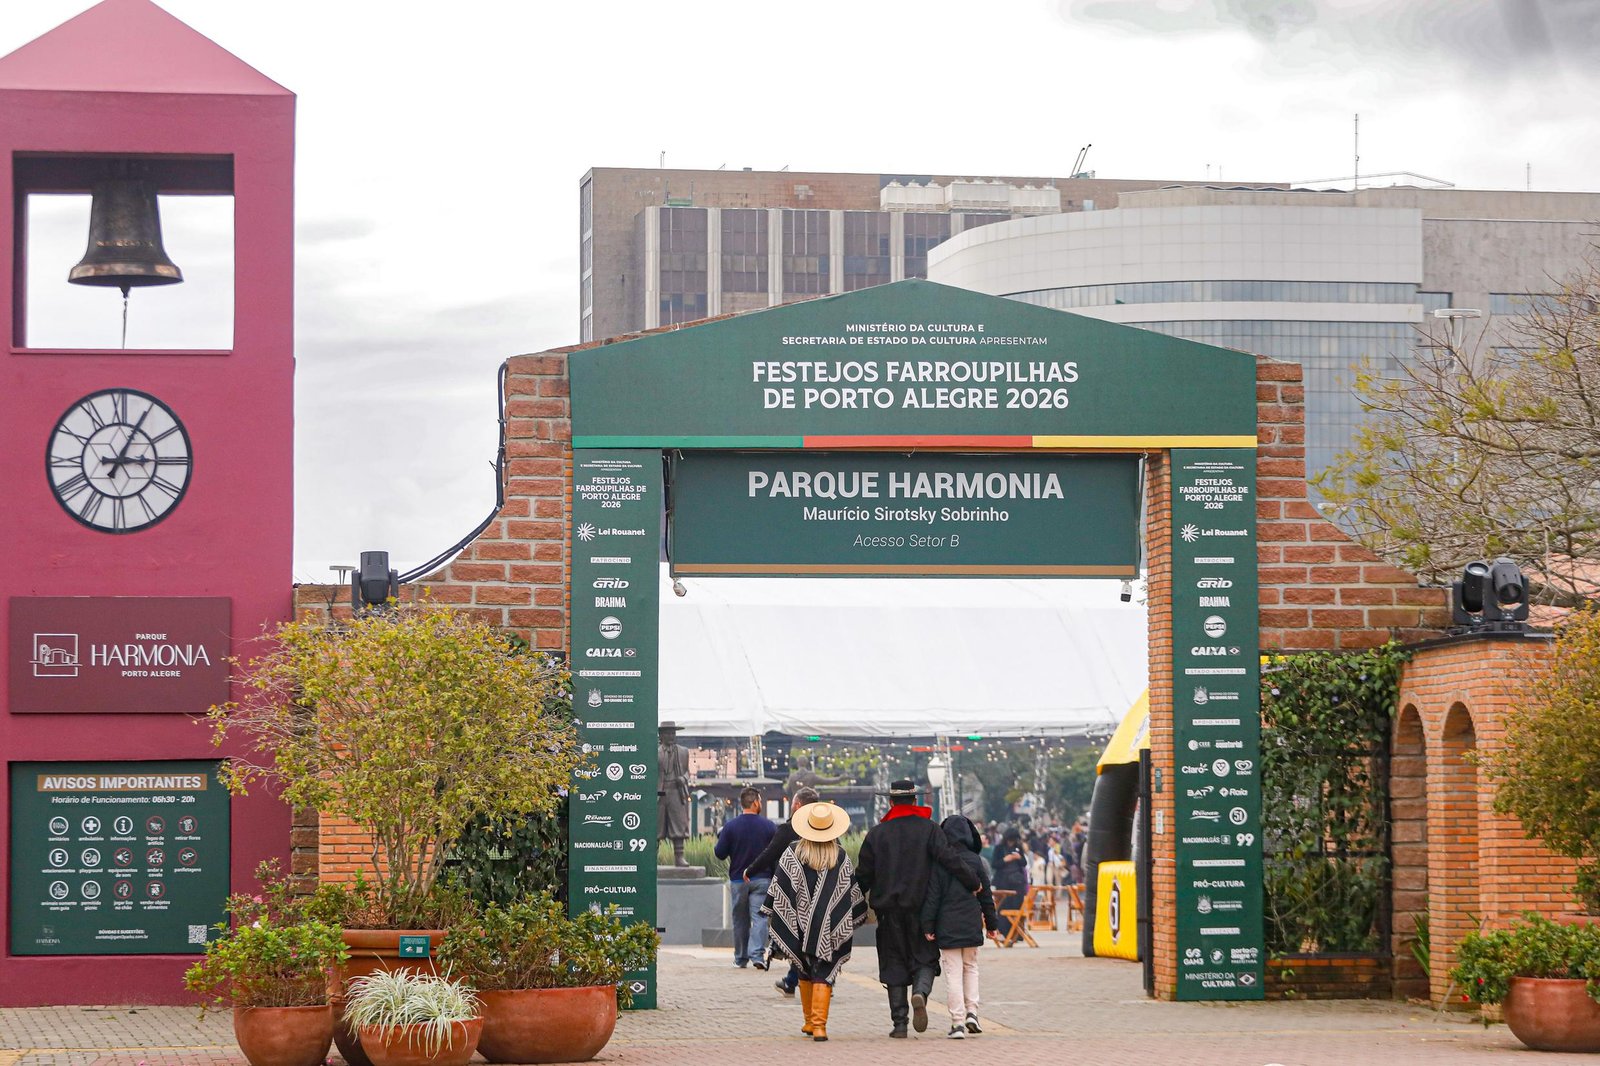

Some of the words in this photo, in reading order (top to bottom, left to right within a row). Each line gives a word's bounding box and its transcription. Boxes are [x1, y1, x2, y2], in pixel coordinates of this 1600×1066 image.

[846, 322, 906, 332] MINISTÉRIO
[910, 324, 924, 332] DA
[927, 324, 975, 332] CULTURA
[978, 324, 984, 332] E
[782, 337, 847, 345] SECRETARIA
[850, 337, 864, 345] DE
[867, 337, 908, 345] ESTADO
[912, 337, 926, 345] DA
[930, 337, 977, 345] CULTURA
[980, 337, 1047, 345] APRESENTAM
[753, 361, 878, 383] FESTEJOS
[887, 361, 1078, 383] FARROUPILHAS
[764, 388, 795, 409] DE
[804, 388, 894, 409] PORTO
[902, 388, 998, 409] ALEGRE
[1006, 388, 1068, 409] 2026
[748, 472, 879, 500] PARQUE
[889, 472, 1064, 499] HARMONIA
[804, 506, 869, 520] Maurício
[874, 507, 936, 524] Sirotsky
[941, 507, 1009, 521] Sobrinho
[853, 534, 904, 547] Acesso
[909, 534, 946, 547] Setor
[950, 535, 959, 547] B
[593, 578, 629, 588] GRID
[1197, 578, 1232, 588] GRID
[595, 597, 626, 607] BRAHMA
[1200, 597, 1230, 607] BRAHMA
[91, 645, 210, 666] HARMONIA
[586, 648, 621, 657] CAIXA
[1191, 647, 1226, 655] CAIXA
[43, 777, 96, 790] AVISOS
[100, 776, 201, 789] IMPORTANTES
[1229, 788, 1248, 796] Raia
[627, 815, 636, 826] 51
[1233, 810, 1243, 822] 51
[1236, 833, 1254, 846] 99
[630, 839, 647, 851] 99
[1193, 879, 1245, 887] PRÓ-CULTURA
[585, 885, 636, 893] PRÓ-CULTURA
